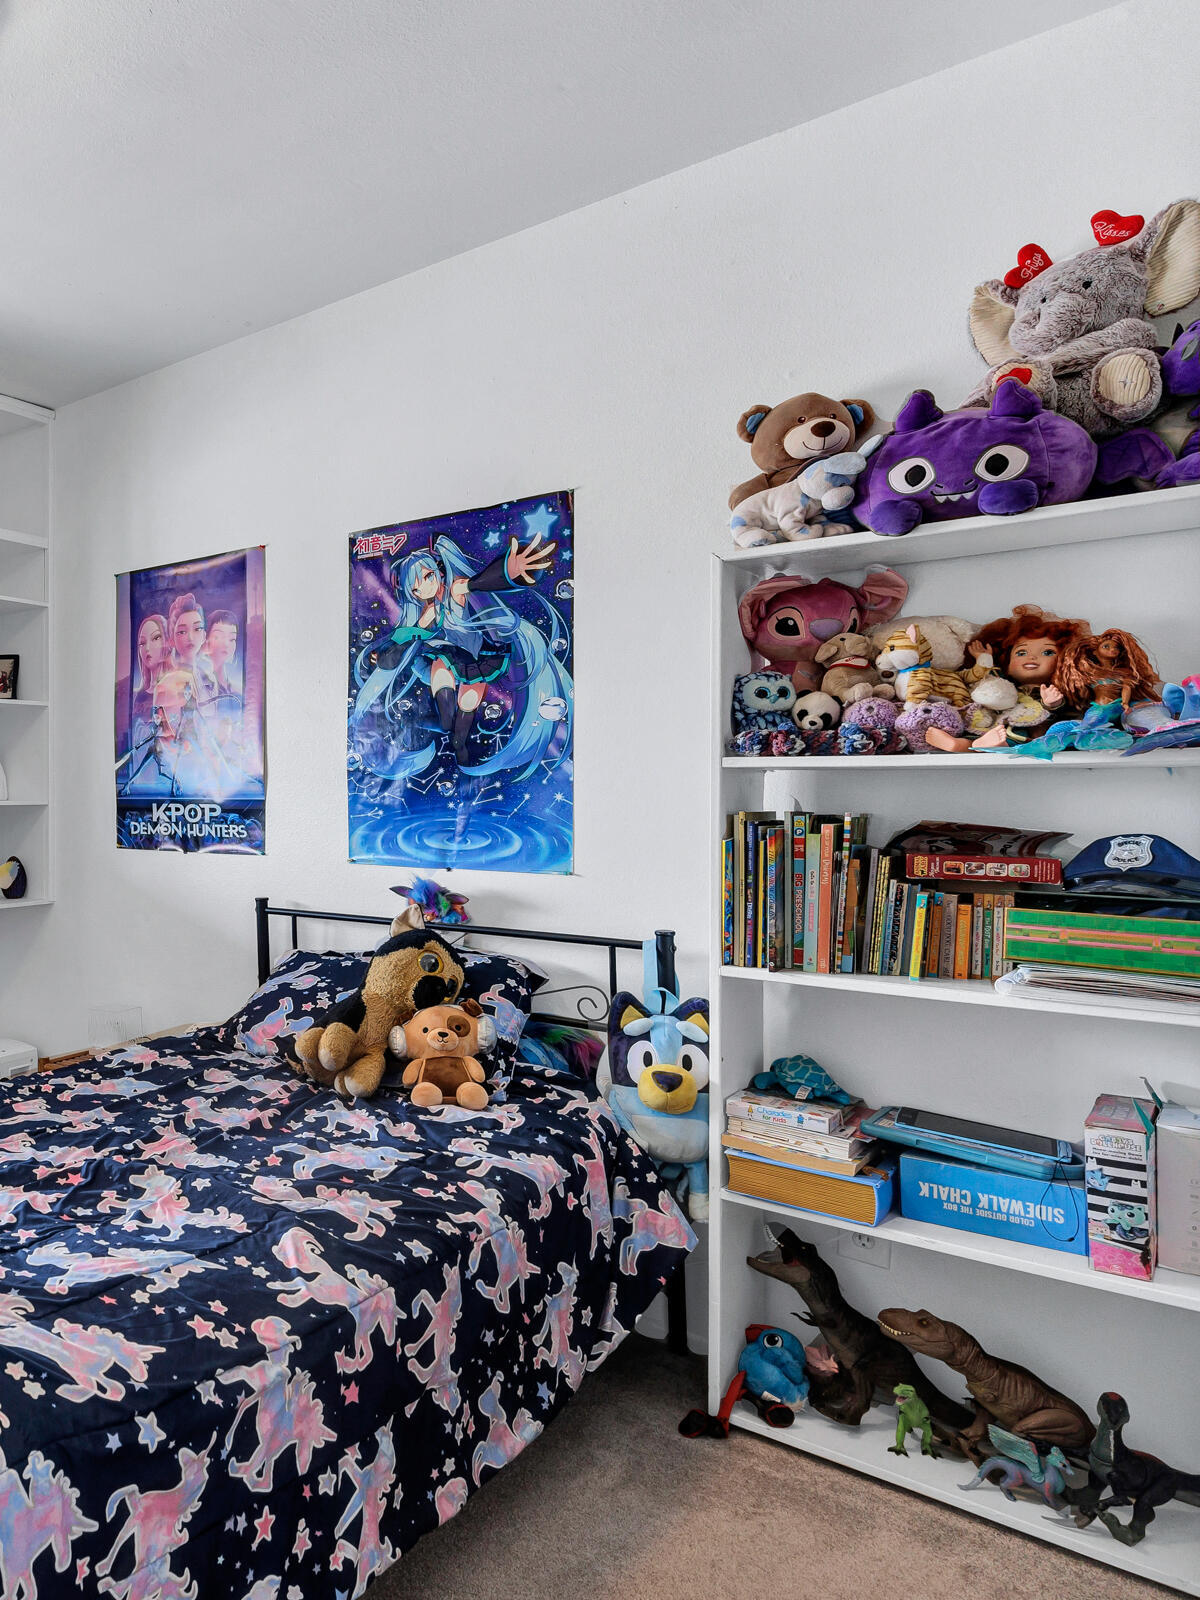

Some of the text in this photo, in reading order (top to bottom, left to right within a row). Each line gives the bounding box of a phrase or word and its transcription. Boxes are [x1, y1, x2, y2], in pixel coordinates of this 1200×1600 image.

[1093, 221, 1131, 240] Kisses
[1020, 252, 1045, 280] Hugs
[353, 533, 407, 556] 初音ミク
[151, 803, 222, 823] KPOP
[130, 821, 248, 838] DEMON HUNTERS
[794, 872, 804, 934] BIG PRESCHOOL
[756, 1106, 793, 1119] Charades
[772, 1116, 787, 1124] Kids
[918, 1181, 1065, 1224] SIDEWALK CHALK
[943, 1202, 1035, 1227] COLOR OUTSIDE THE BOX
